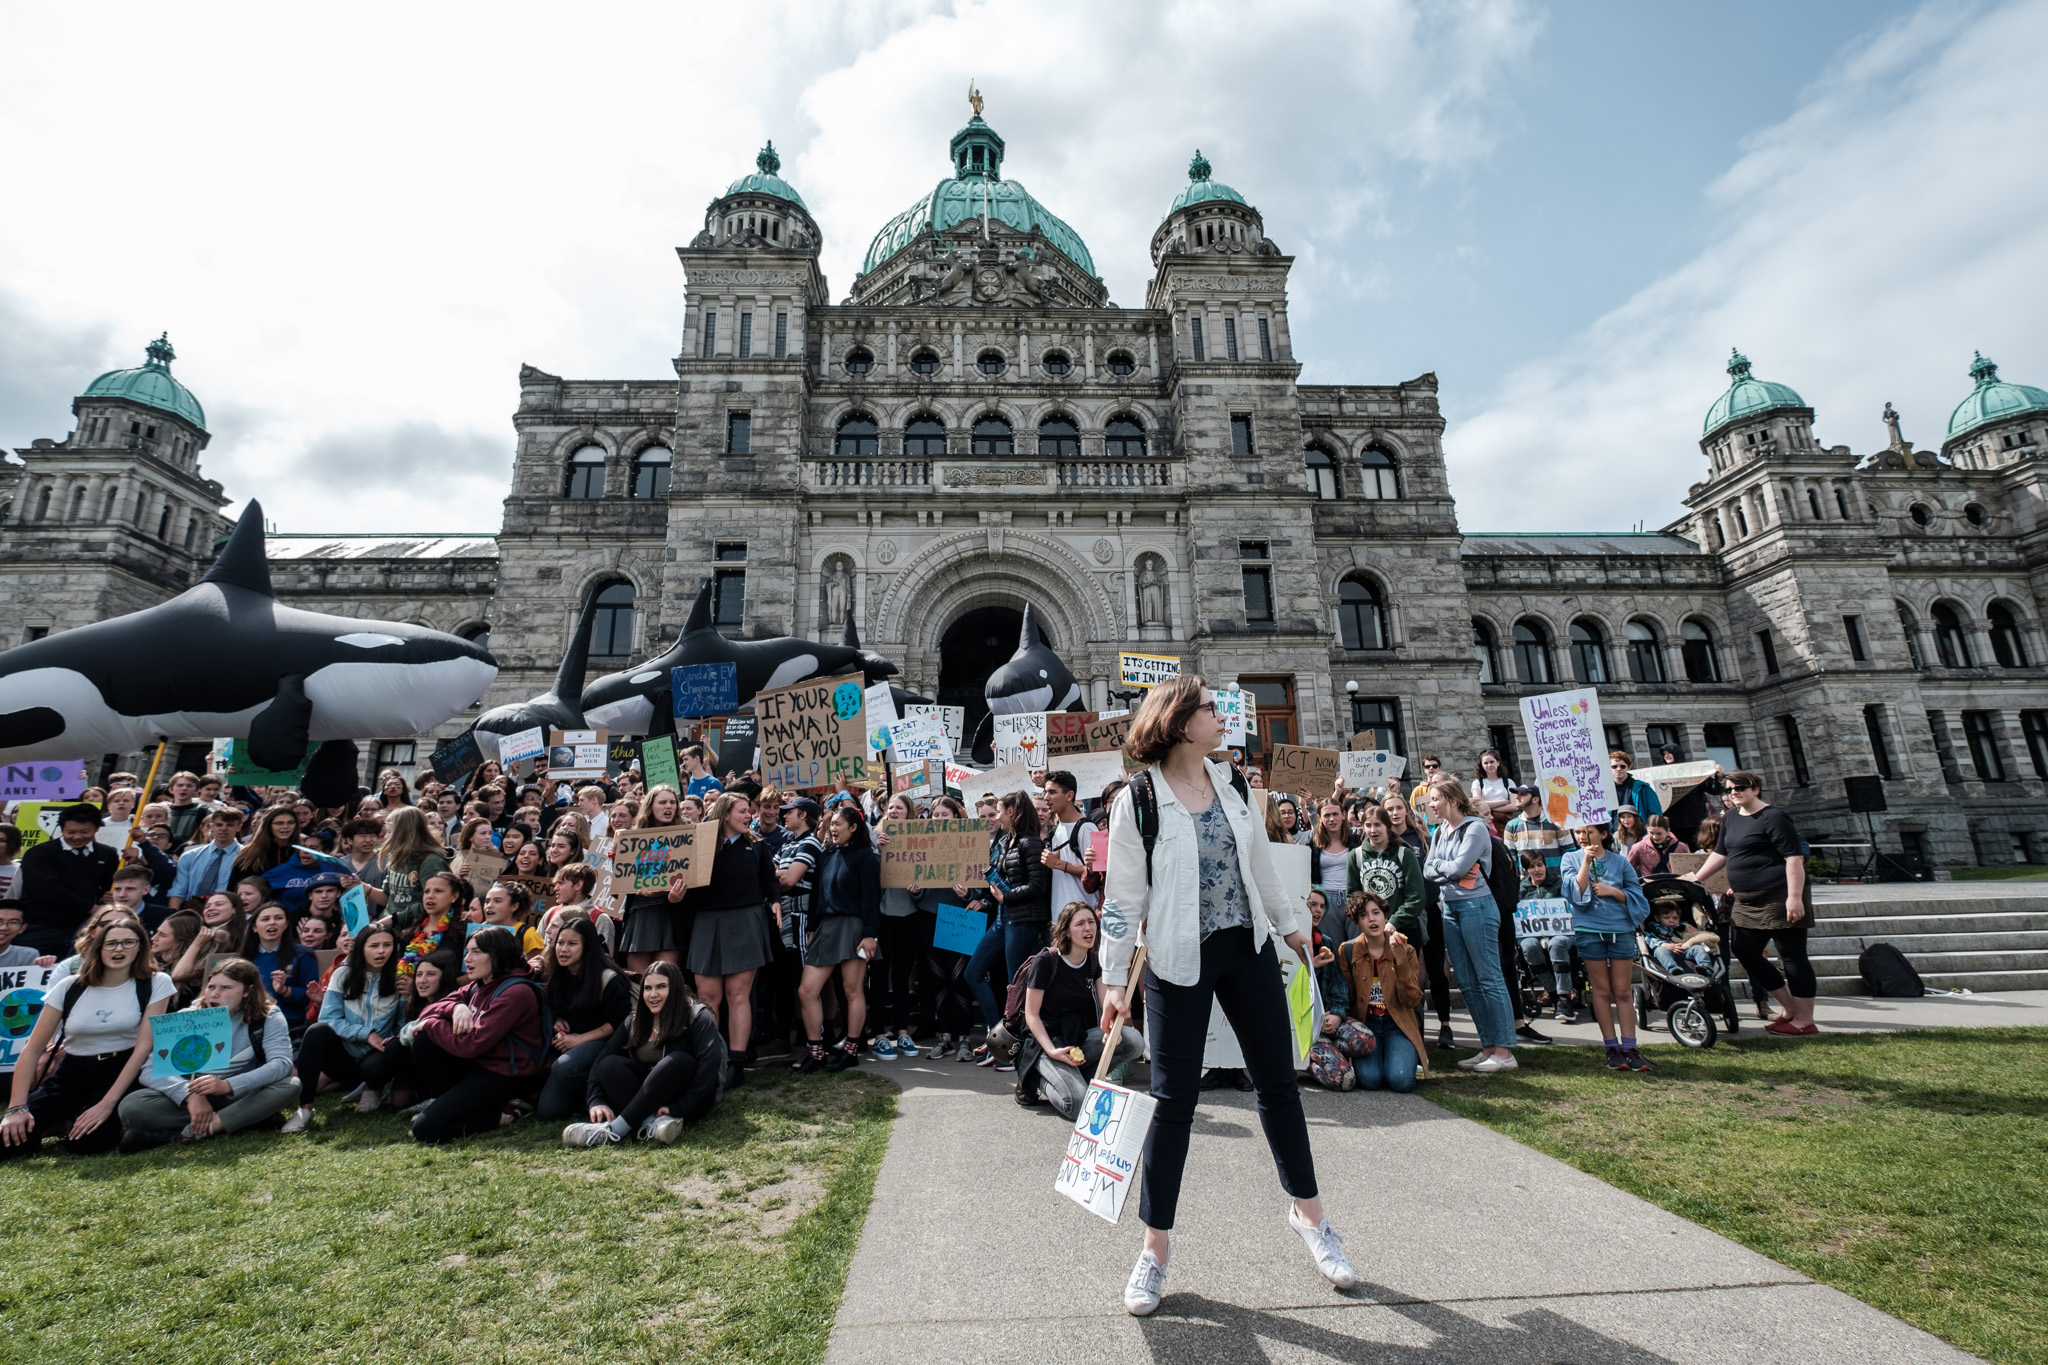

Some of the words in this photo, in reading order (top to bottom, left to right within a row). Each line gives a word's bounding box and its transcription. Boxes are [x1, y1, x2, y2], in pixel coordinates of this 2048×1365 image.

[721, 665, 736, 679] EV
[1144, 660, 1180, 674] GETTING
[1142, 673, 1155, 683] IN
[719, 680, 731, 692] all
[1229, 691, 1240, 699] THE
[760, 693, 786, 720] IF
[788, 688, 831, 713] YOUR
[1530, 697, 1569, 720] Unless
[763, 715, 823, 743] MAMA
[826, 711, 840, 734] IS
[891, 725, 900, 735] I
[1012, 714, 1044, 733] HOUSE
[1050, 713, 1093, 735] SEX
[1091, 722, 1119, 740] CUT
[1064, 734, 1079, 743] THAT
[1535, 731, 1554, 745] like
[1555, 732, 1570, 746] you
[765, 740, 805, 767] SICK
[811, 735, 841, 760] YOU
[898, 748, 930, 759] THEY
[1537, 747, 1544, 756] a
[1545, 741, 1572, 753] whole
[1573, 738, 1593, 752] awful
[1275, 747, 1309, 771] ACT
[1315, 755, 1338, 769] NOW
[1348, 751, 1376, 764] Planet
[768, 761, 820, 792] HELP
[826, 756, 867, 784] HER
[945, 765, 959, 783] WE
[1349, 768, 1374, 778] Profit
[1571, 766, 1579, 777] is
[1304, 776, 1332, 789] LATER
[1576, 776, 1585, 788] to
[0, 787, 37, 795] ANET
[58, 787, 66, 795] B
[619, 837, 655, 854] STOP
[656, 833, 693, 849] SAVING
[939, 836, 953, 849] A
[640, 848, 672, 863] EGOS
[885, 851, 927, 863] PLEASE
[614, 861, 654, 879] START
[653, 858, 690, 878] SAVING
[633, 875, 668, 889] ECOS
[1520, 917, 1550, 933] NOT
[0, 970, 28, 990] KE
[154, 1012, 178, 1025] WHAT
[187, 1009, 214, 1021] STAND
[155, 1026, 178, 1036] WHAT
[184, 1022, 211, 1033] STAND
[1083, 1171, 1116, 1217] WE
